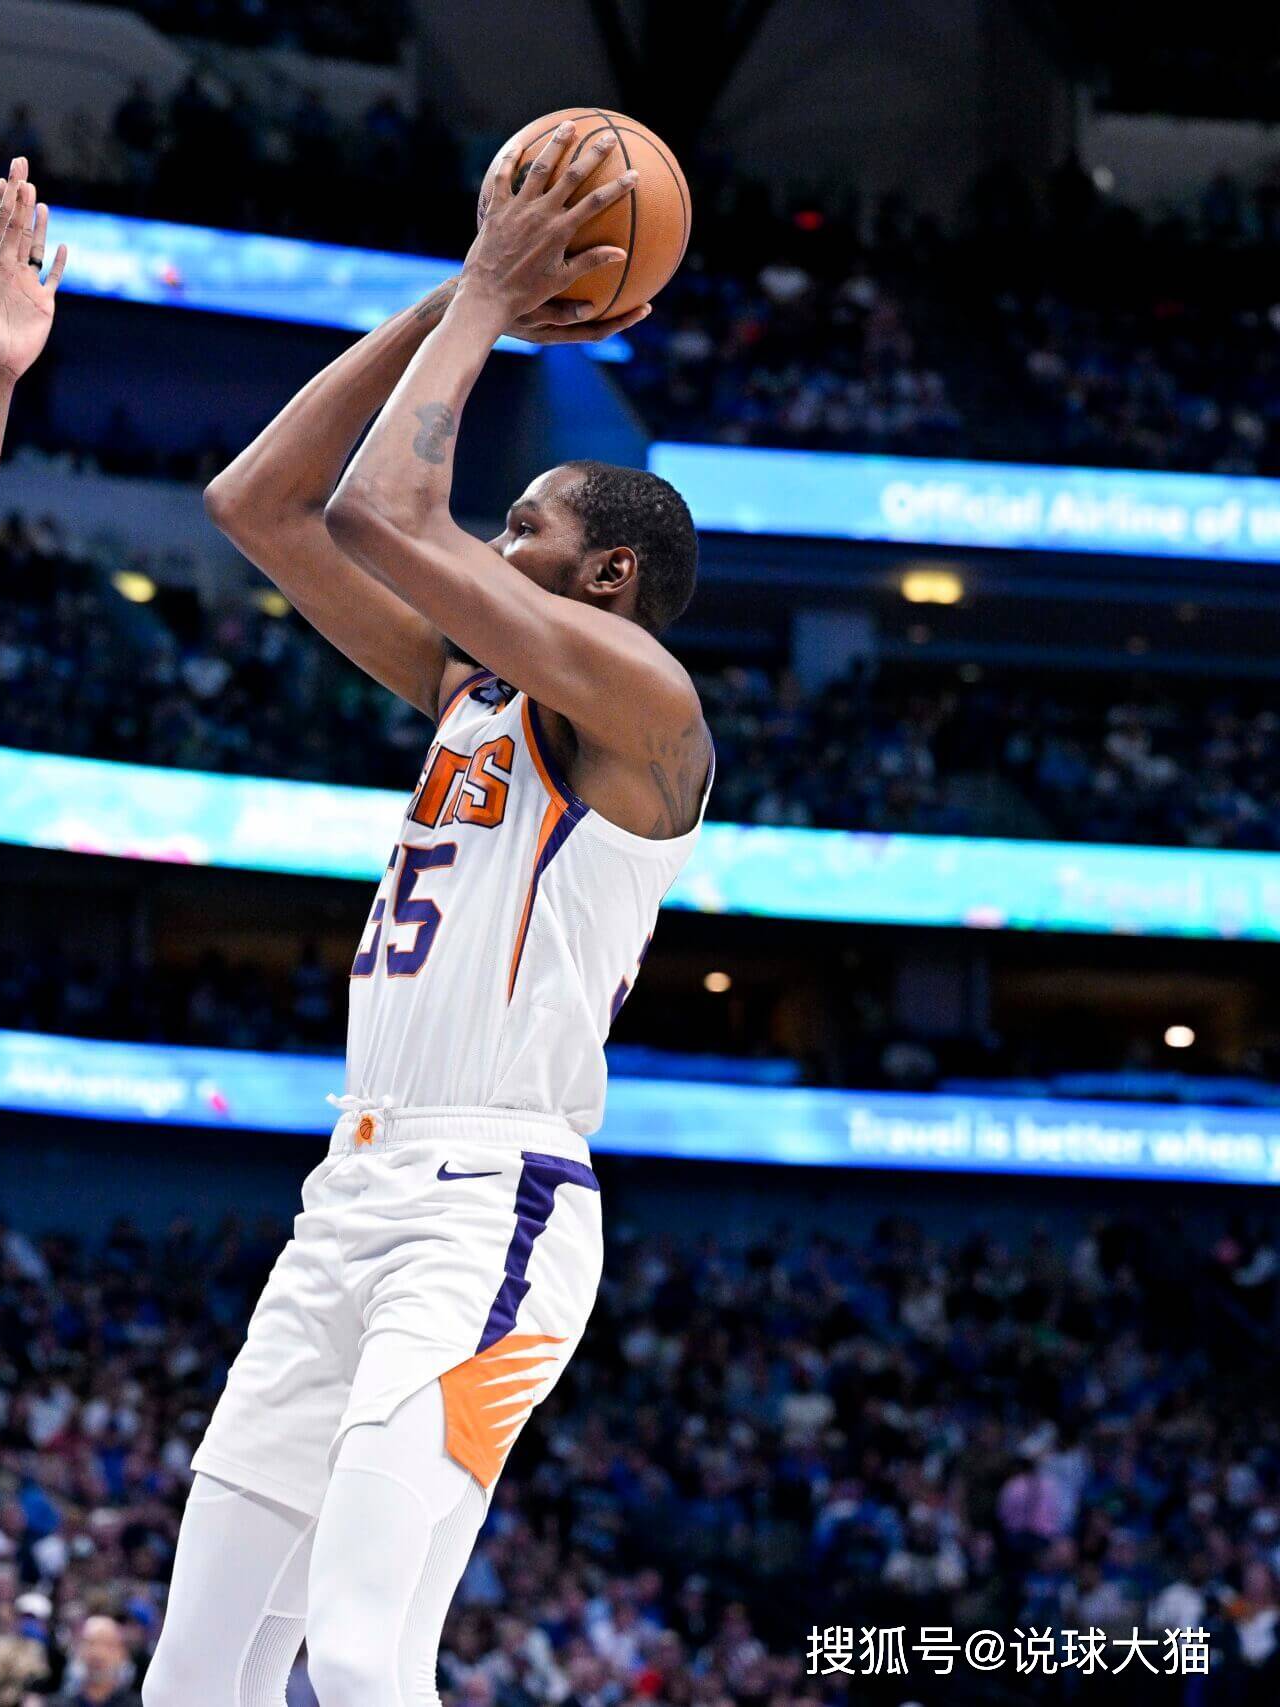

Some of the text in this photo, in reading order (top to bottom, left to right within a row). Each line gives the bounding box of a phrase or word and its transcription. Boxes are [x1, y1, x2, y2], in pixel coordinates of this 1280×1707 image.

[879, 479, 1042, 536] Official
[1048, 490, 1190, 541] Airline
[1193, 496, 1245, 545] of
[849, 1107, 971, 1156] Travel
[975, 1112, 1009, 1159] is
[1014, 1113, 1144, 1164] better
[1147, 1121, 1265, 1169] when
